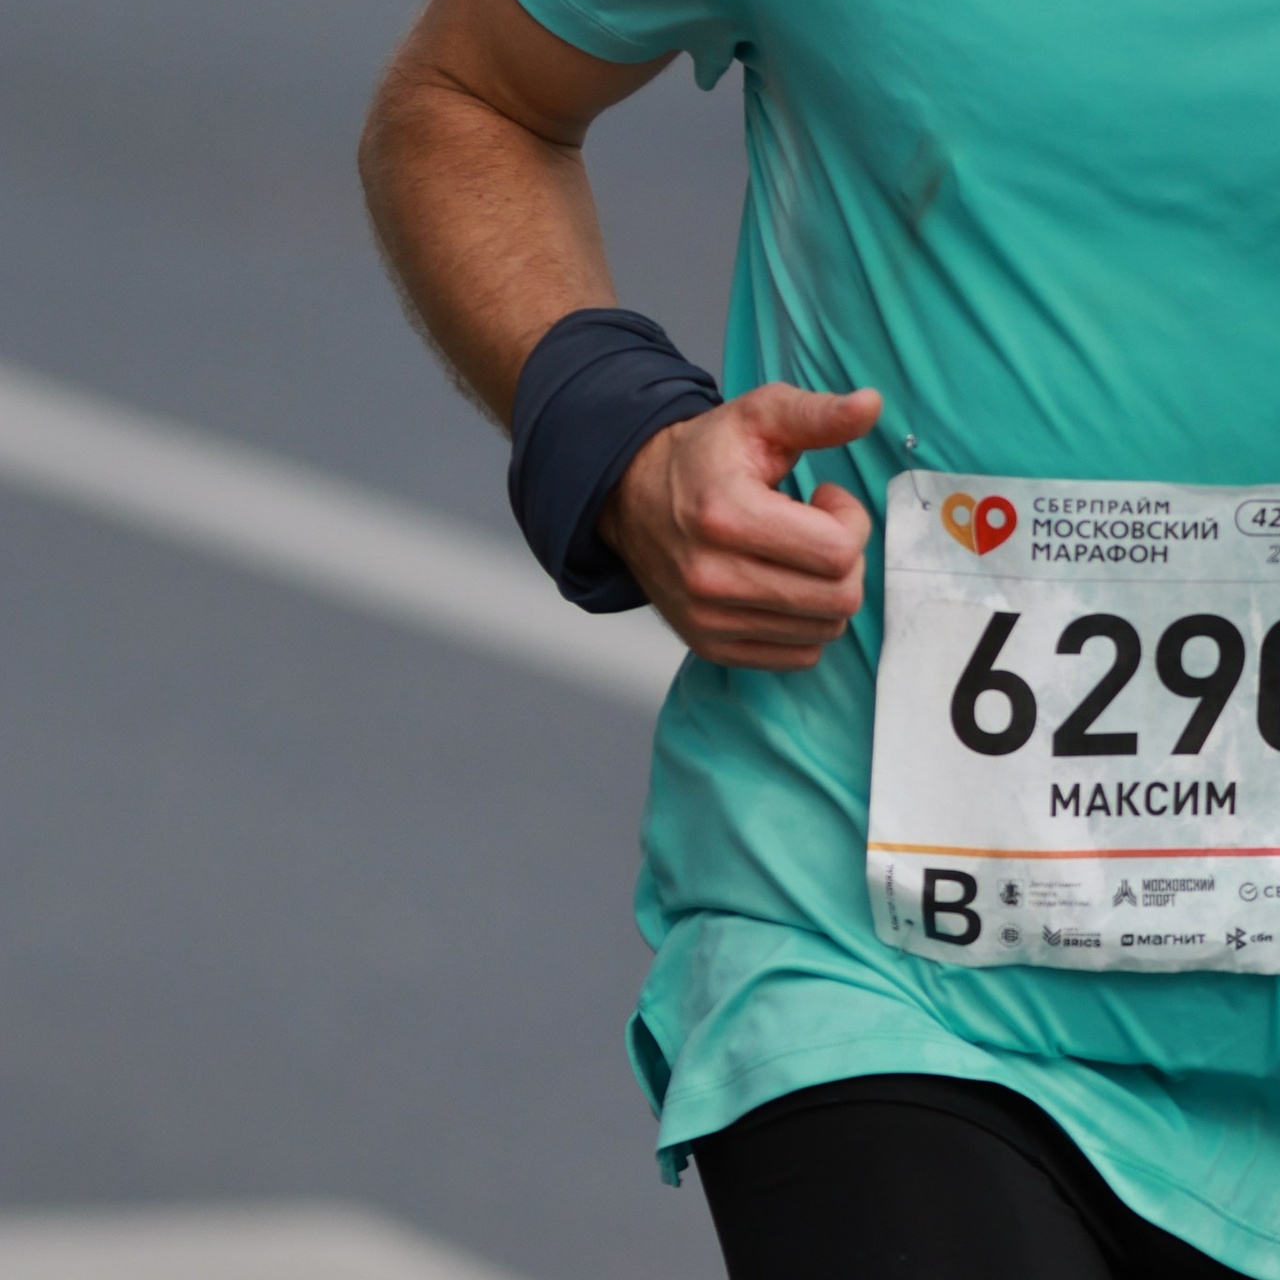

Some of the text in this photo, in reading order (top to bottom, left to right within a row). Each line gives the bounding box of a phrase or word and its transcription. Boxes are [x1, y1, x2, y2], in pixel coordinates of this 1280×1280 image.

[1033, 496, 1171, 515] СБЕРПРАЙМ
[1031, 517, 1219, 541] МОСКОВСКИЙ
[1031, 542, 1169, 564] МАРАФОН
[1050, 781, 1237, 818] МАКСИМ
[1142, 875, 1215, 892] МОСКОВСКИЙ
[1142, 893, 1176, 908] СПОРТ
